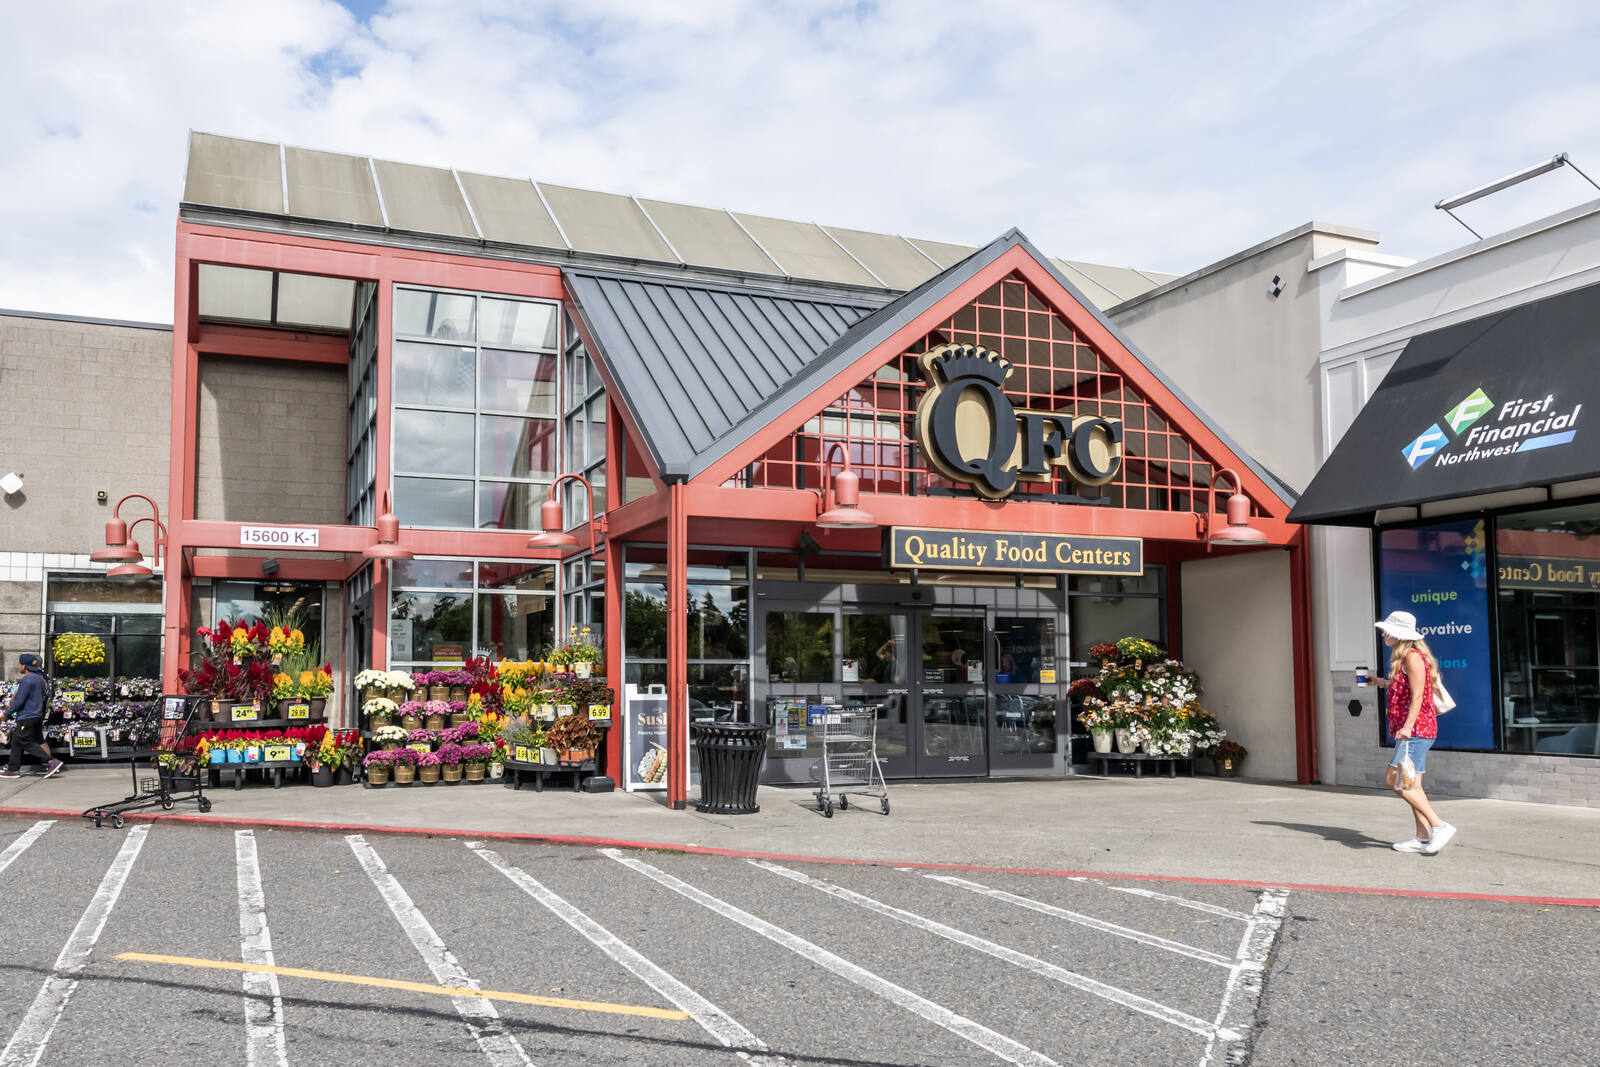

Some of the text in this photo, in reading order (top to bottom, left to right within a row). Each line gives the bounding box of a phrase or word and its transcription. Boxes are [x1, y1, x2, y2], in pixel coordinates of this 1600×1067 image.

[1498, 394, 1554, 421] First
[930, 374, 1123, 492] QFC
[1465, 404, 1582, 447] Financial
[1435, 441, 1520, 467] Northwest
[243, 530, 317, 544] 15600 K-1
[904, 535, 1131, 566] Quality Food Centers
[1411, 588, 1458, 605] unique
[592, 709, 607, 717] 6.99
